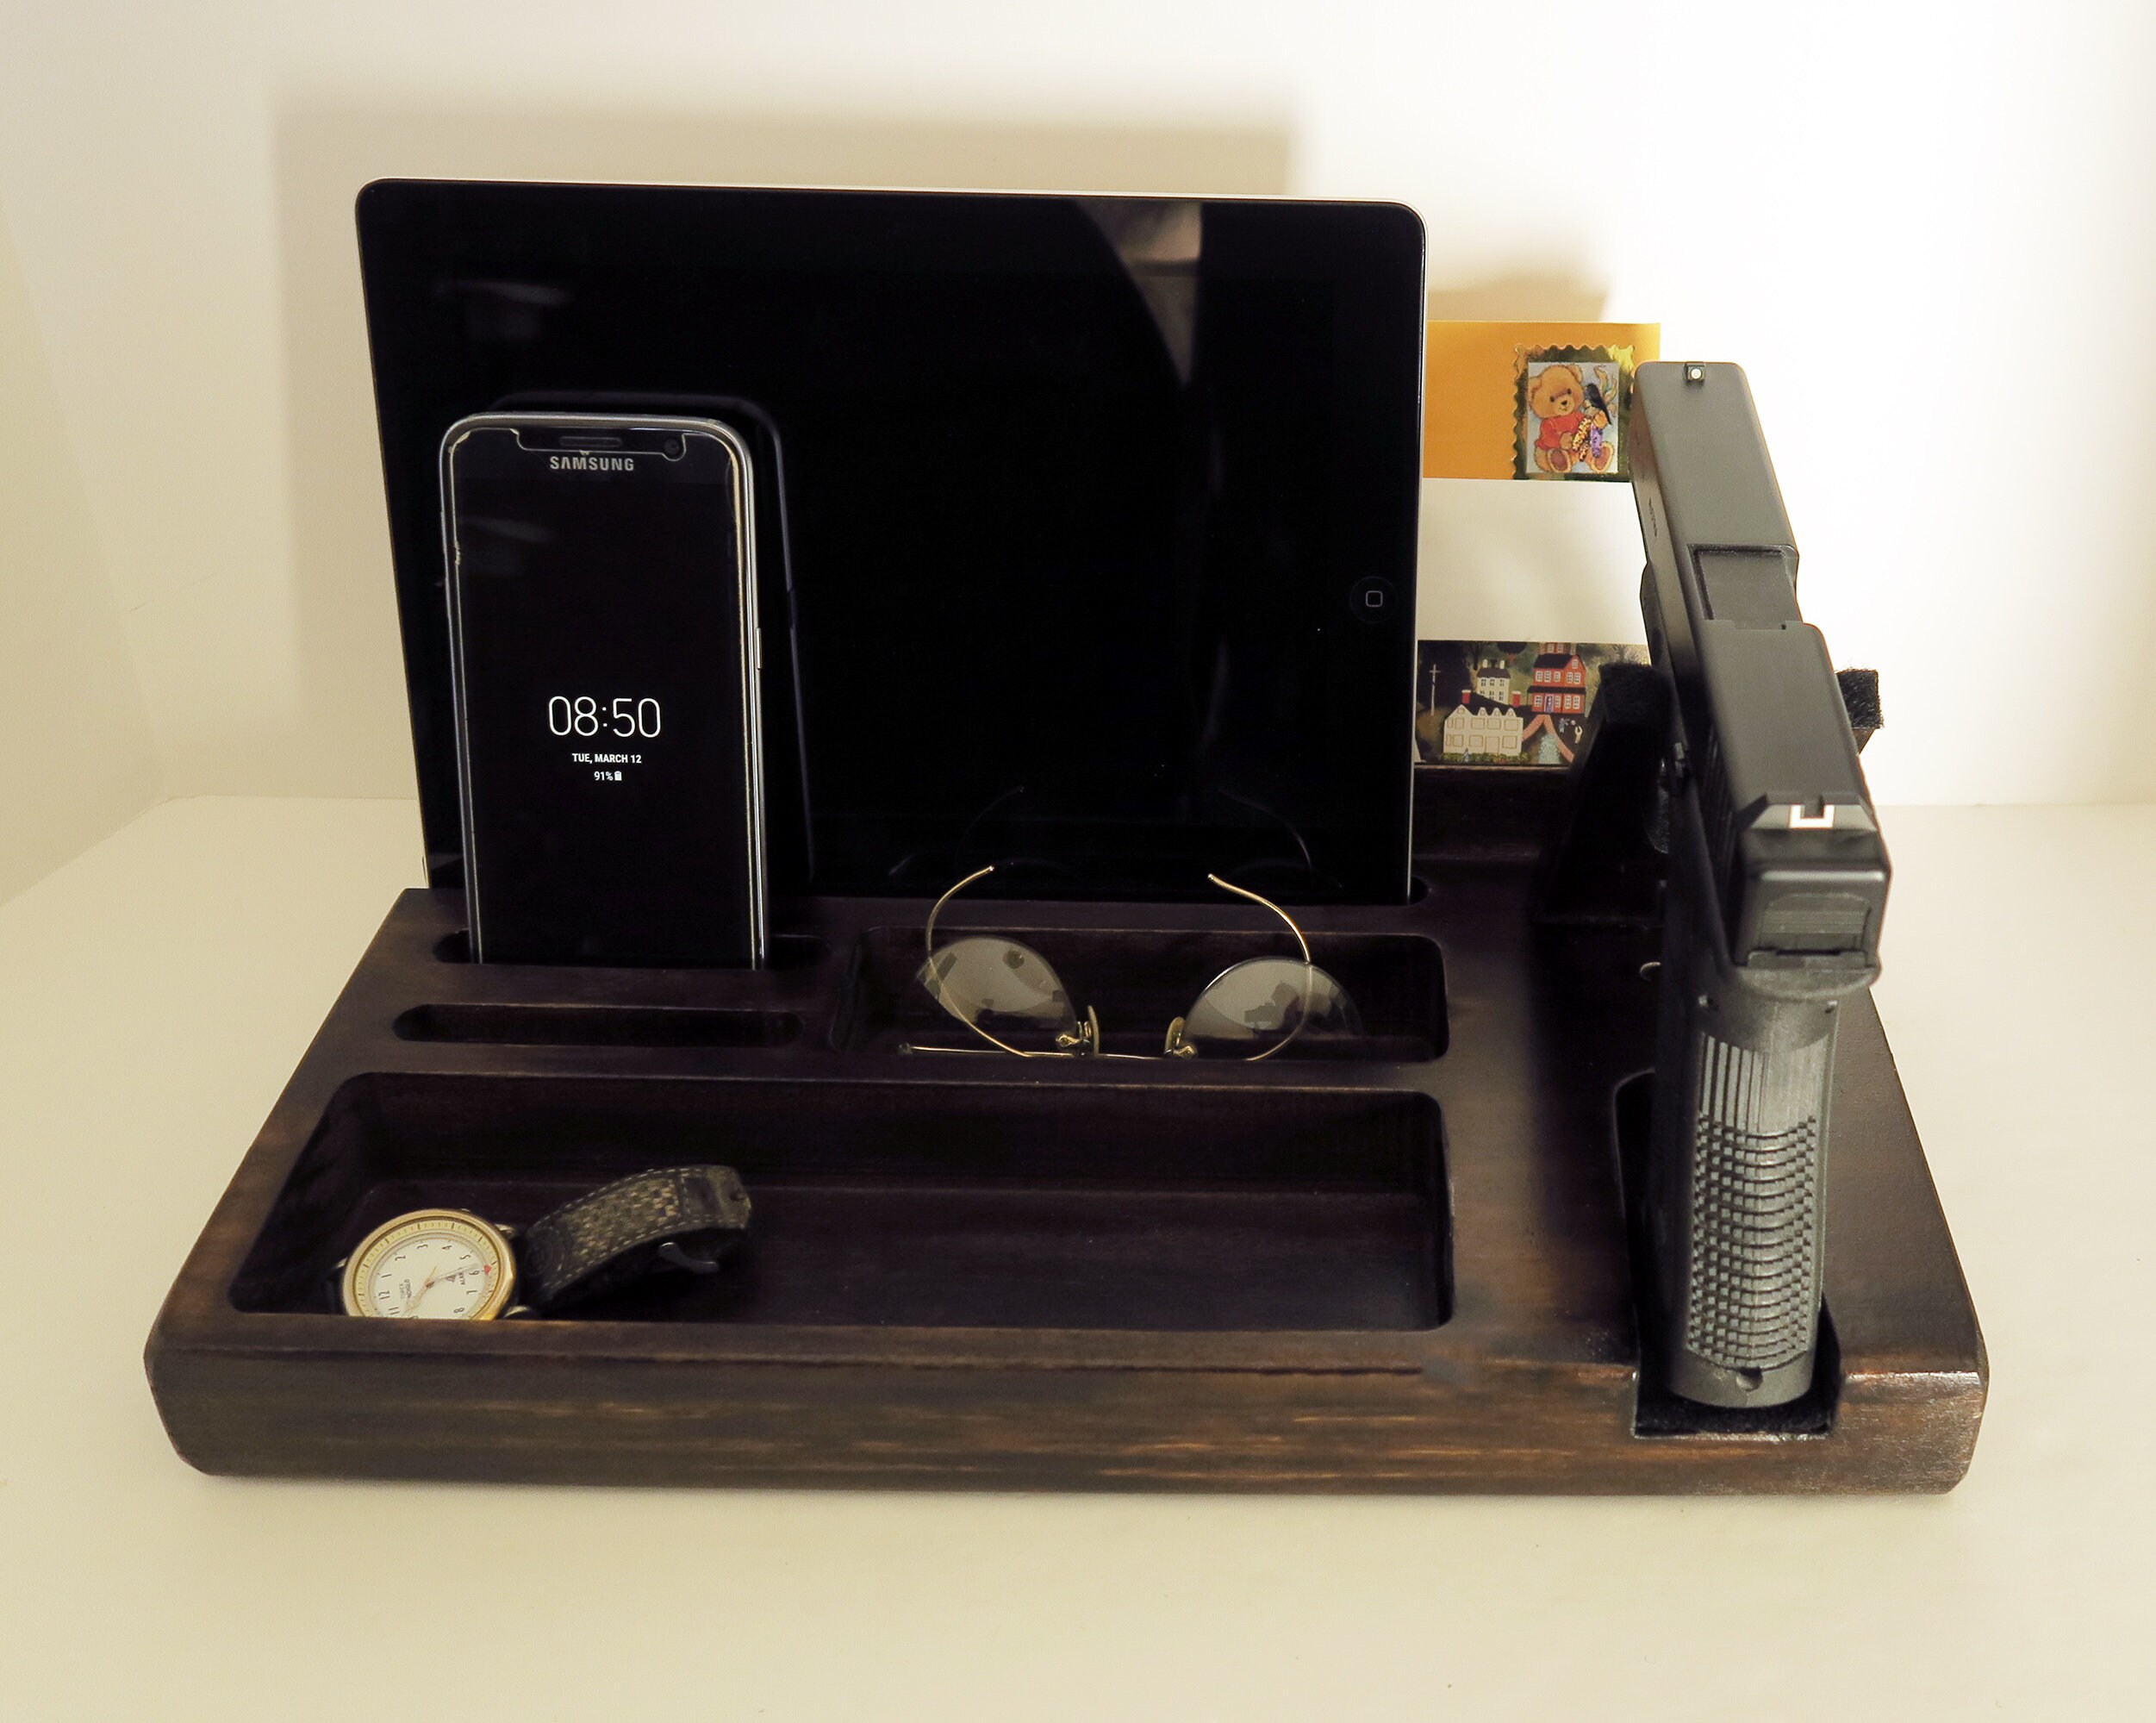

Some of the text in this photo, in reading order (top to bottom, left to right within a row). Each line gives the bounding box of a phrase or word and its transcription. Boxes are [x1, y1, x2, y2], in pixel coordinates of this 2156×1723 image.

[550, 456, 634, 471] SAMSUNG
[548, 696, 661, 738] 08:50
[572, 752, 642, 764] TUE, MARCH 12
[594, 771, 614, 781] 91%
[378, 1290, 390, 1301] 12
[388, 1307, 400, 1315] 11
